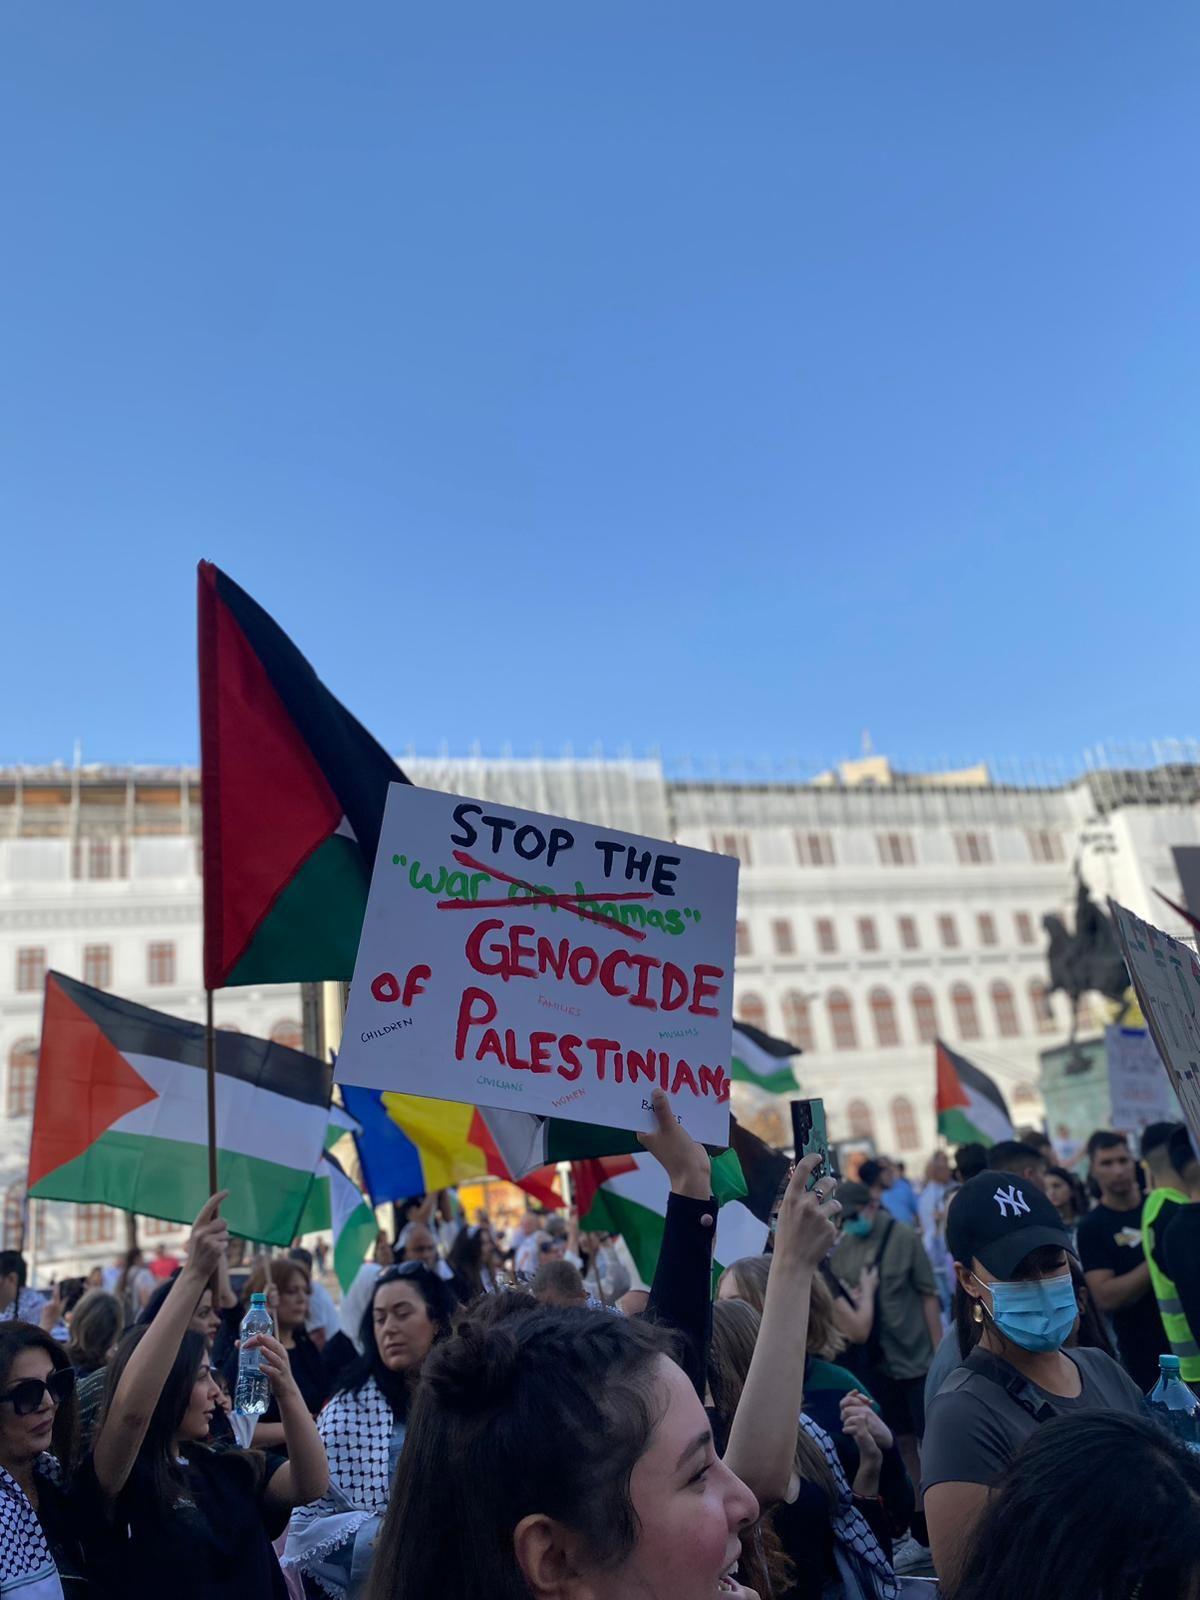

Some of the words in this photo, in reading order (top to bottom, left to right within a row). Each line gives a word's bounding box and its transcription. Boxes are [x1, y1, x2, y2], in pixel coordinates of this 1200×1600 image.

[451, 803, 574, 867] STOP
[595, 840, 681, 896] THE
[465, 919, 724, 1017] GENOCIDE
[360, 1017, 413, 1043] CHILDREN
[455, 986, 731, 1104] PALESTINIANS
[476, 1074, 524, 1093] CIVILIANS
[550, 1086, 586, 1108] WOMEN
[993, 1185, 1031, 1217] NY
